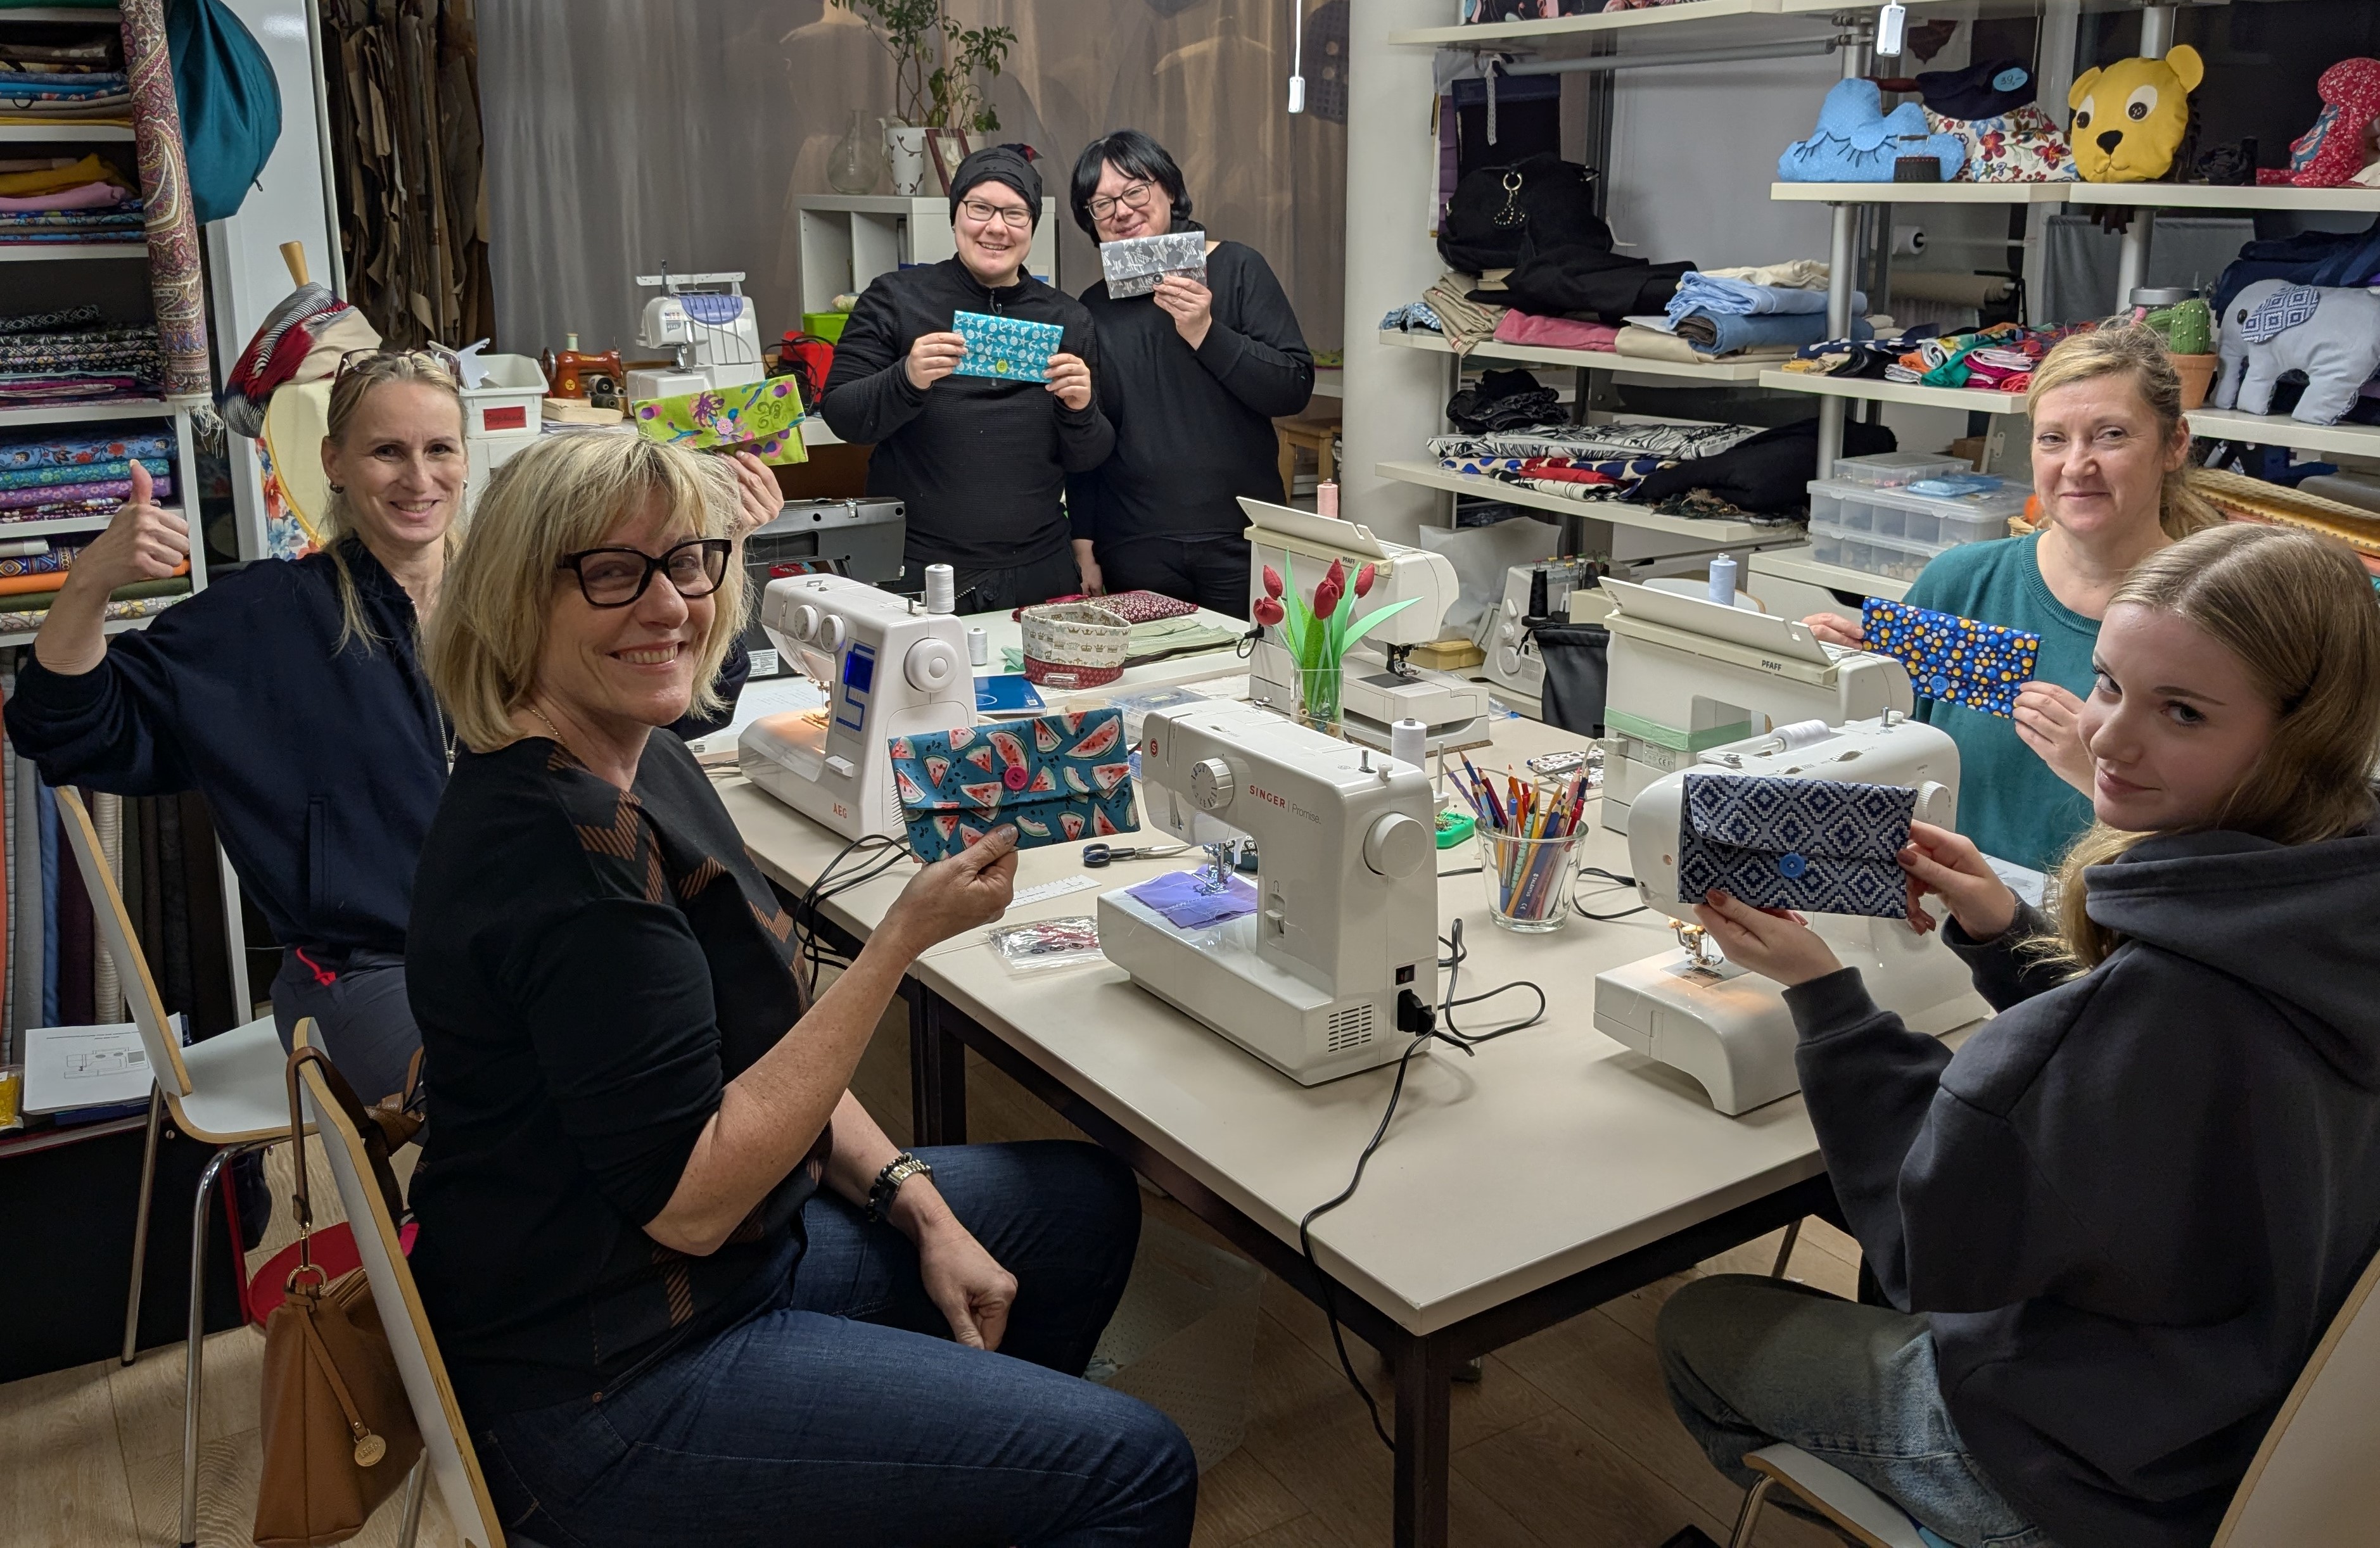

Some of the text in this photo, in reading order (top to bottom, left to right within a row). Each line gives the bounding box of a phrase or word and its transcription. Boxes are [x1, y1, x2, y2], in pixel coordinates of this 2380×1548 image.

[1342, 556, 1356, 564] PFAFF
[1762, 659, 1782, 671] PFAFF
[833, 802, 847, 819] AEG
[1249, 785, 1320, 823] SINGER Promise
